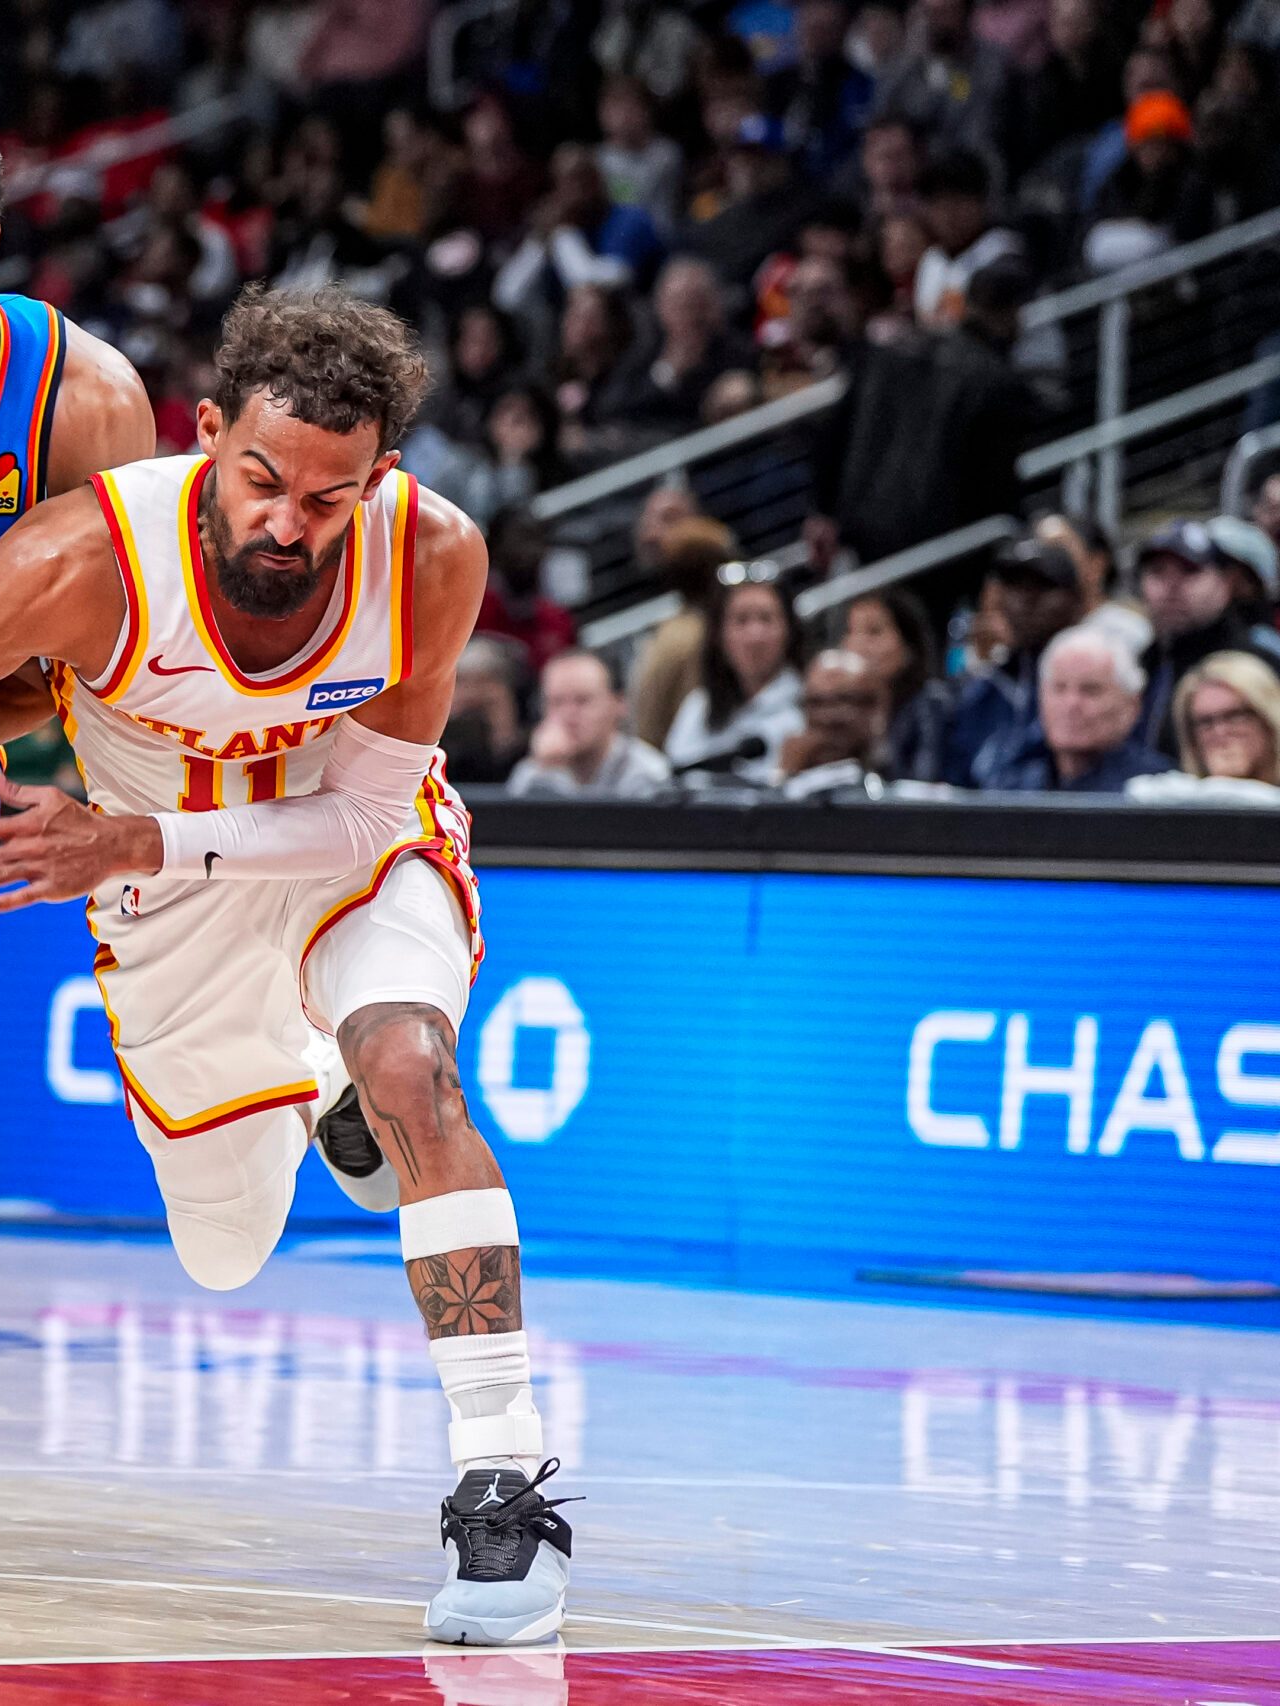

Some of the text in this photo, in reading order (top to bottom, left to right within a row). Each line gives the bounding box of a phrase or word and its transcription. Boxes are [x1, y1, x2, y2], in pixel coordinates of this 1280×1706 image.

[311, 685, 378, 706] paze
[133, 713, 342, 760] TLANT
[178, 752, 287, 813] 11
[907, 1009, 1280, 1166] CHAS
